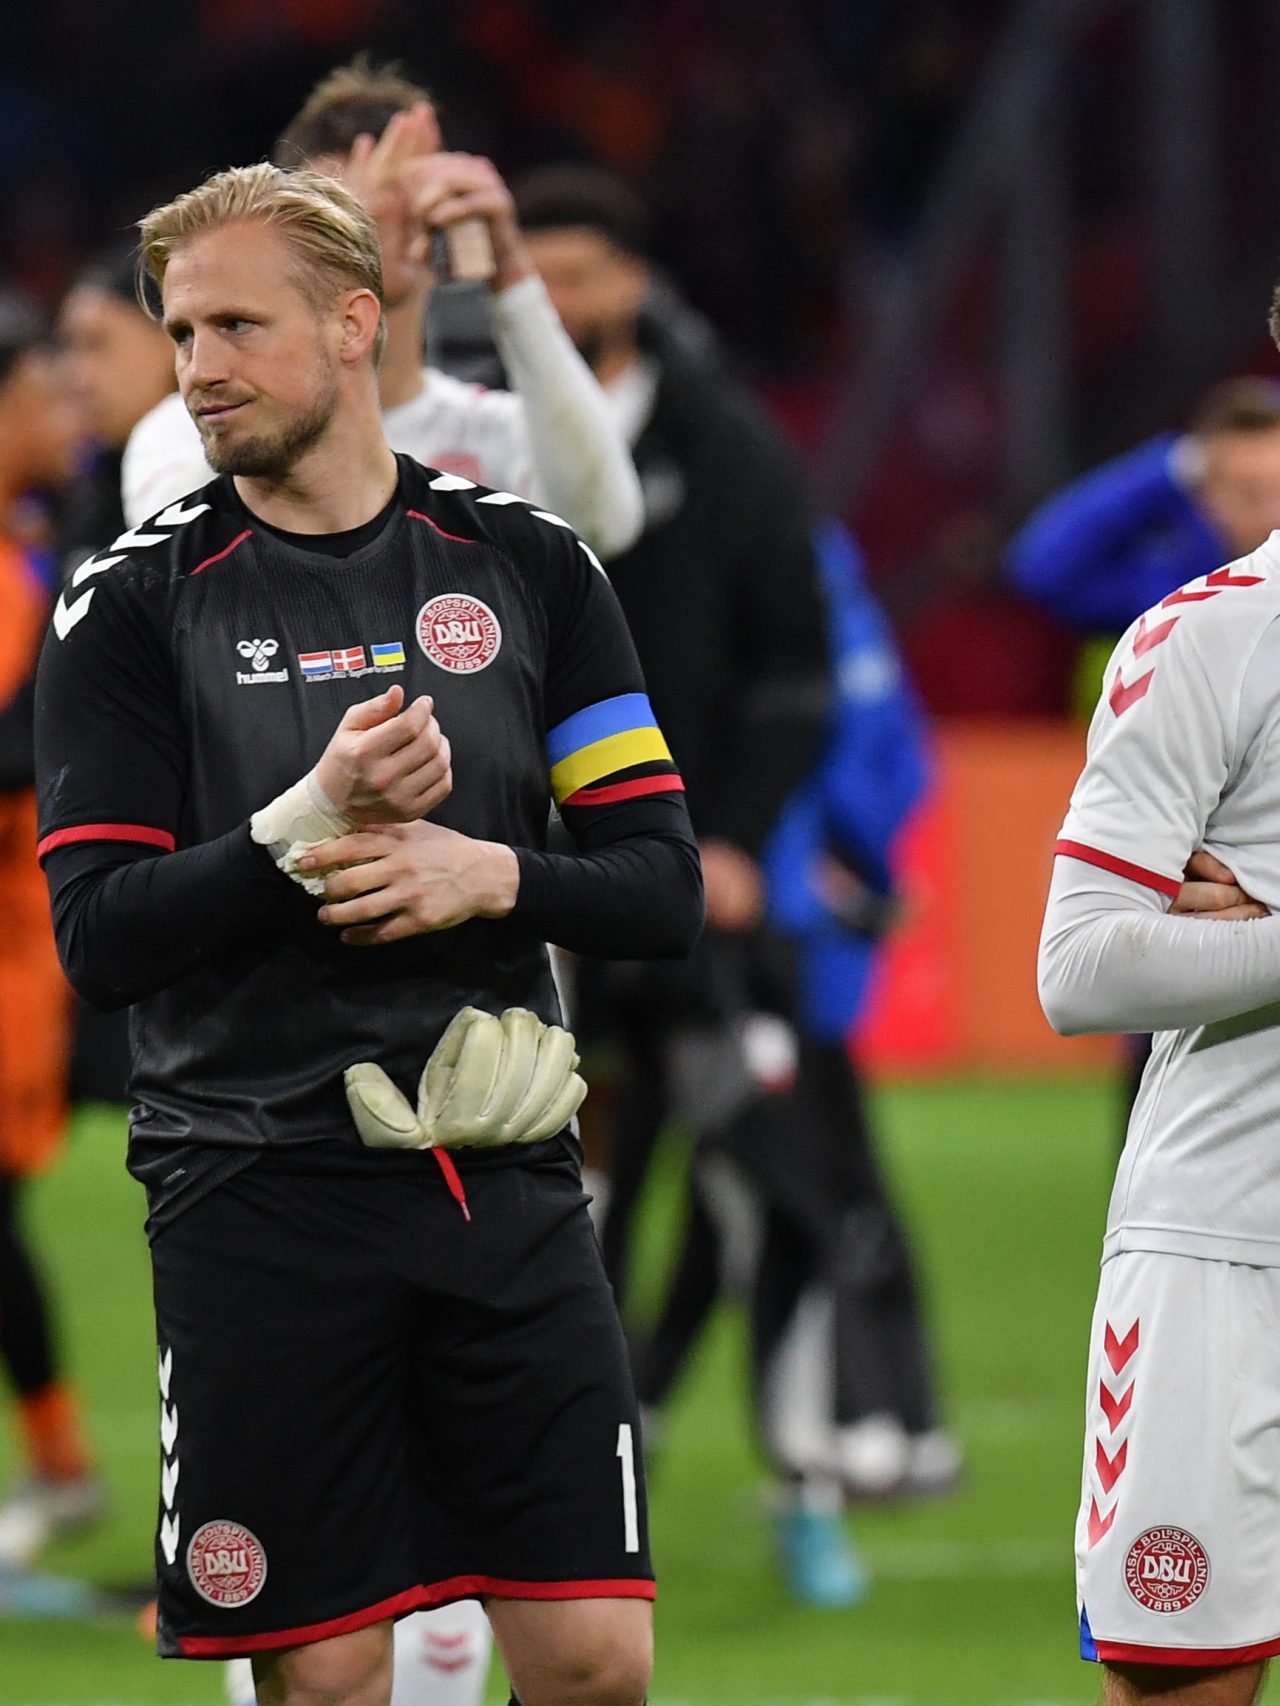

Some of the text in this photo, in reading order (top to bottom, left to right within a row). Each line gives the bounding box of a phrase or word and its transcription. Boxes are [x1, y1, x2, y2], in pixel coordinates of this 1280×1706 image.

[433, 620, 482, 645] DBU
[616, 1423, 640, 1553] 1
[205, 1549, 250, 1575] DBU
[1127, 1547, 1146, 1600] DANSK
[1141, 1555, 1192, 1583] DBU
[1146, 1598, 1182, 1612] 1889
